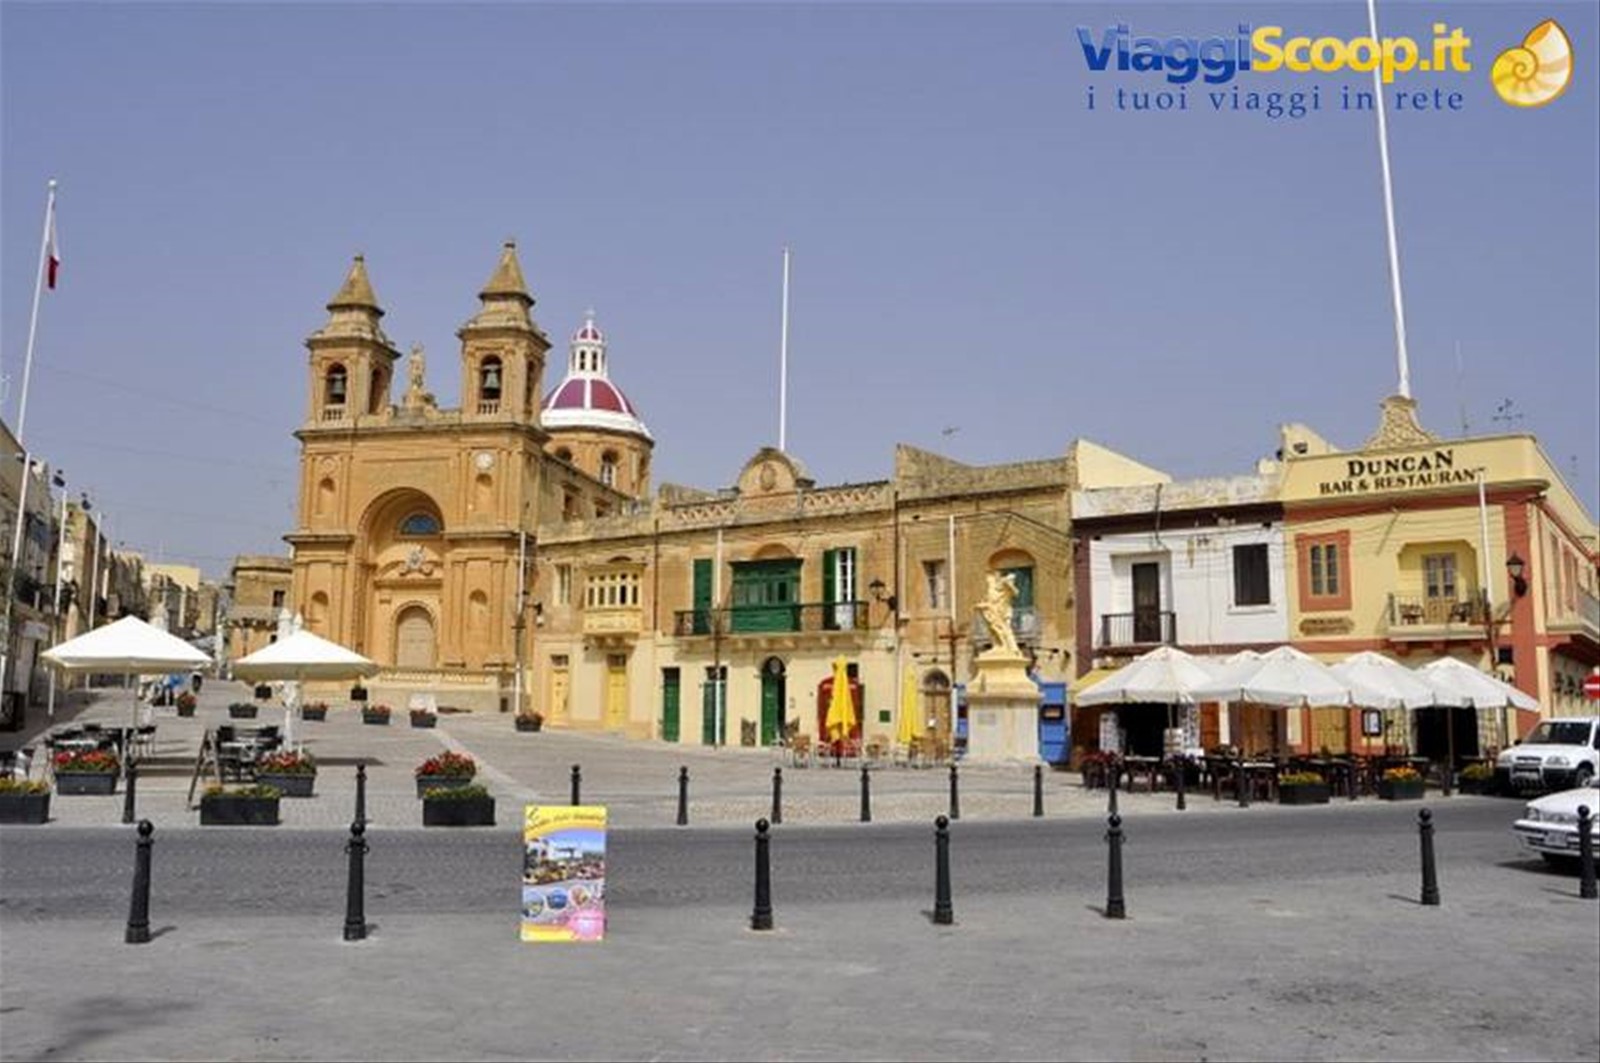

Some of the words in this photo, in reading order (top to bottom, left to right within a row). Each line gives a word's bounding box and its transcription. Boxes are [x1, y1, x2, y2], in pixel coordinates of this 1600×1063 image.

[1347, 449, 1453, 477] DUNCAN
[1319, 480, 1353, 495] BAR
[1358, 478, 1368, 491] &
